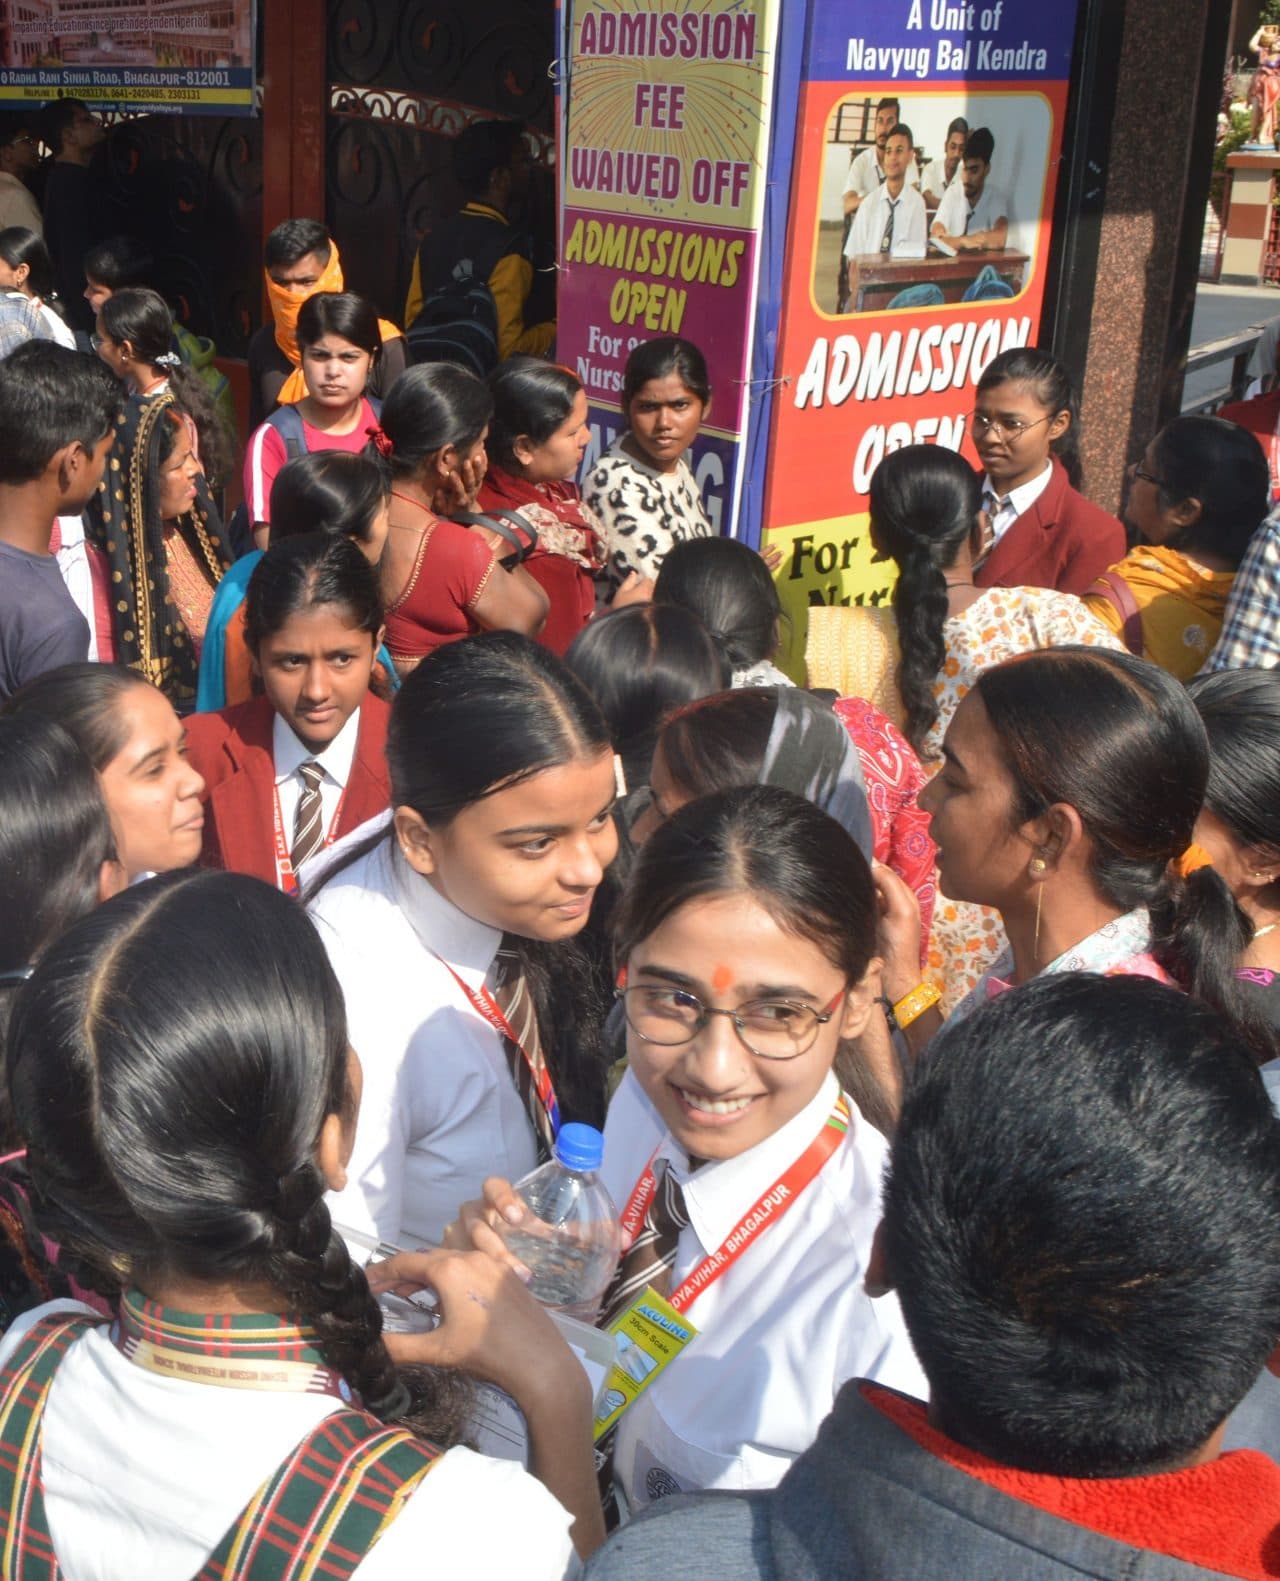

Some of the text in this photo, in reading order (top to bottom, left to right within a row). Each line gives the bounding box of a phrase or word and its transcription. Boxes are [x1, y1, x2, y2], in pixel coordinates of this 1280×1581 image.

[580, 12, 756, 60] ADMISSION
[906, 0, 1003, 31] A Unit of
[846, 38, 1048, 78] Navyug Bal Kendra
[634, 84, 685, 130] FEE
[572, 147, 750, 208] WAIVED OFF
[565, 218, 745, 287] ADMISSIONS
[609, 277, 687, 334] OPEN
[587, 325, 623, 358] For
[789, 535, 860, 580] For
[725, 1184, 792, 1254] BHAGALPUR
